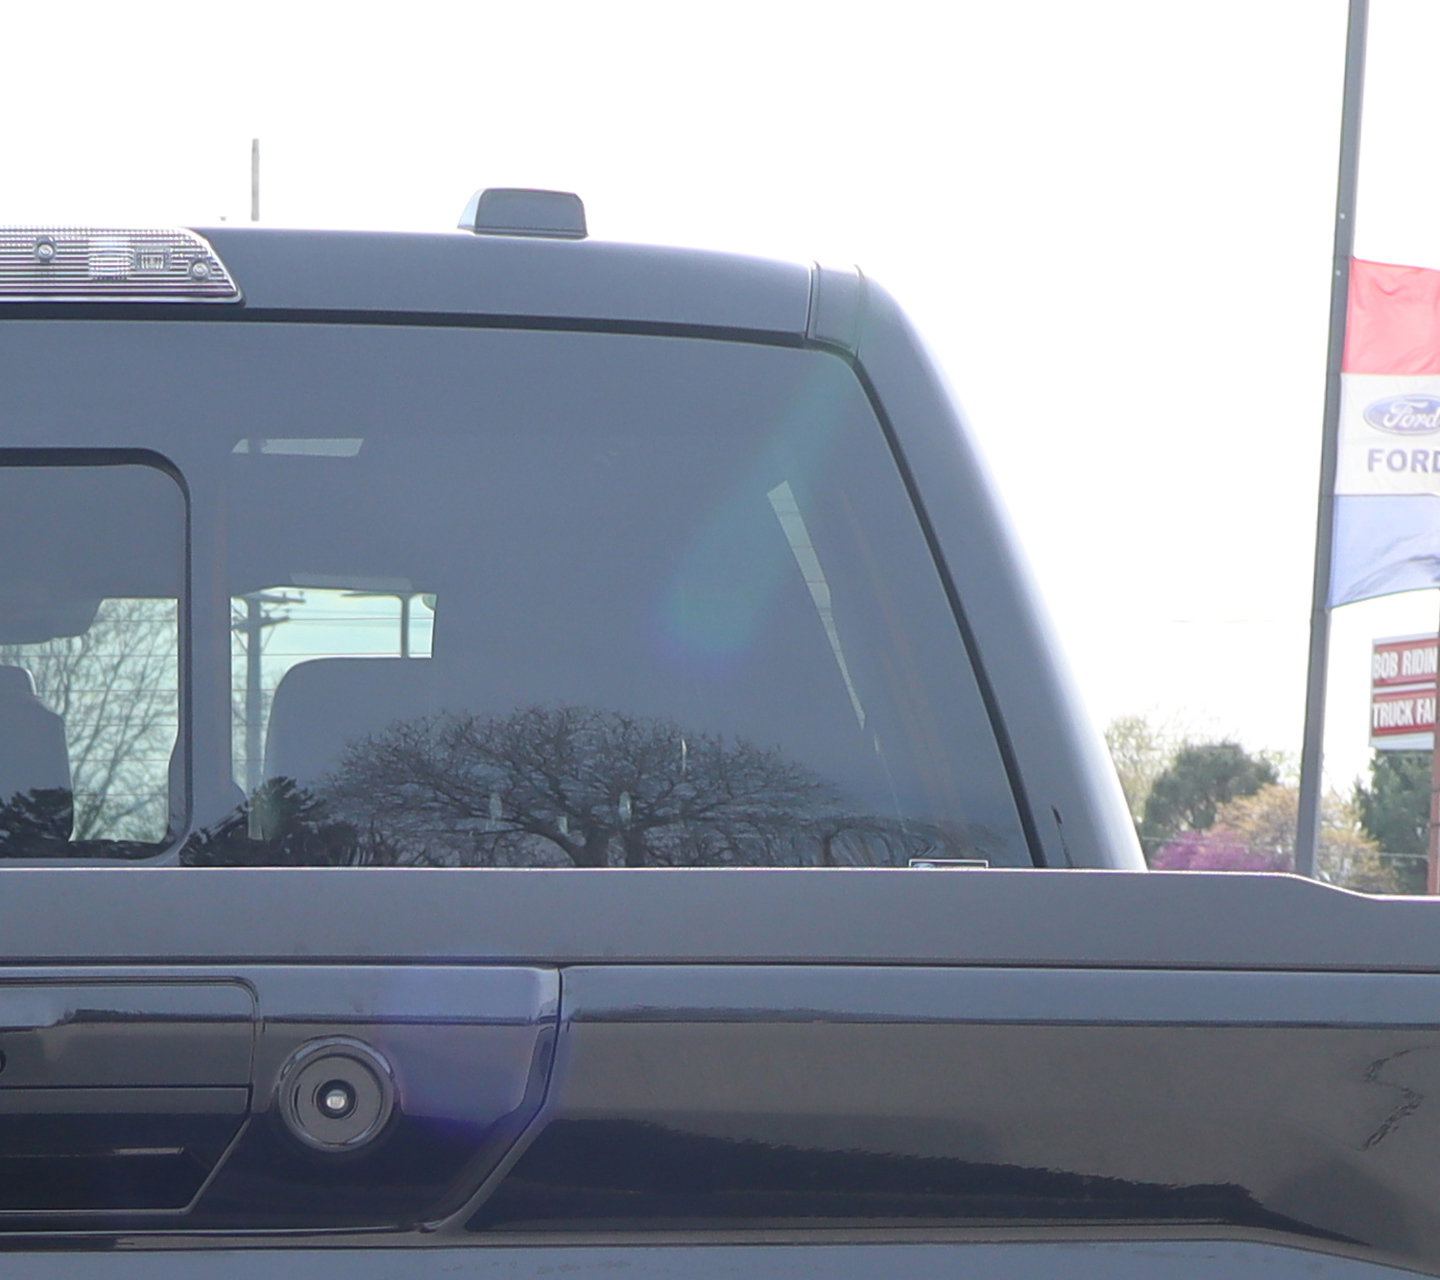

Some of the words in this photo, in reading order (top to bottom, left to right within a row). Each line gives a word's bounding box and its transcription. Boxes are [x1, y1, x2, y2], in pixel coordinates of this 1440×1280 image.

[1373, 652, 1398, 678] BOB
[1402, 646, 1438, 676] RIDIN
[1373, 700, 1413, 728] TRUCK
